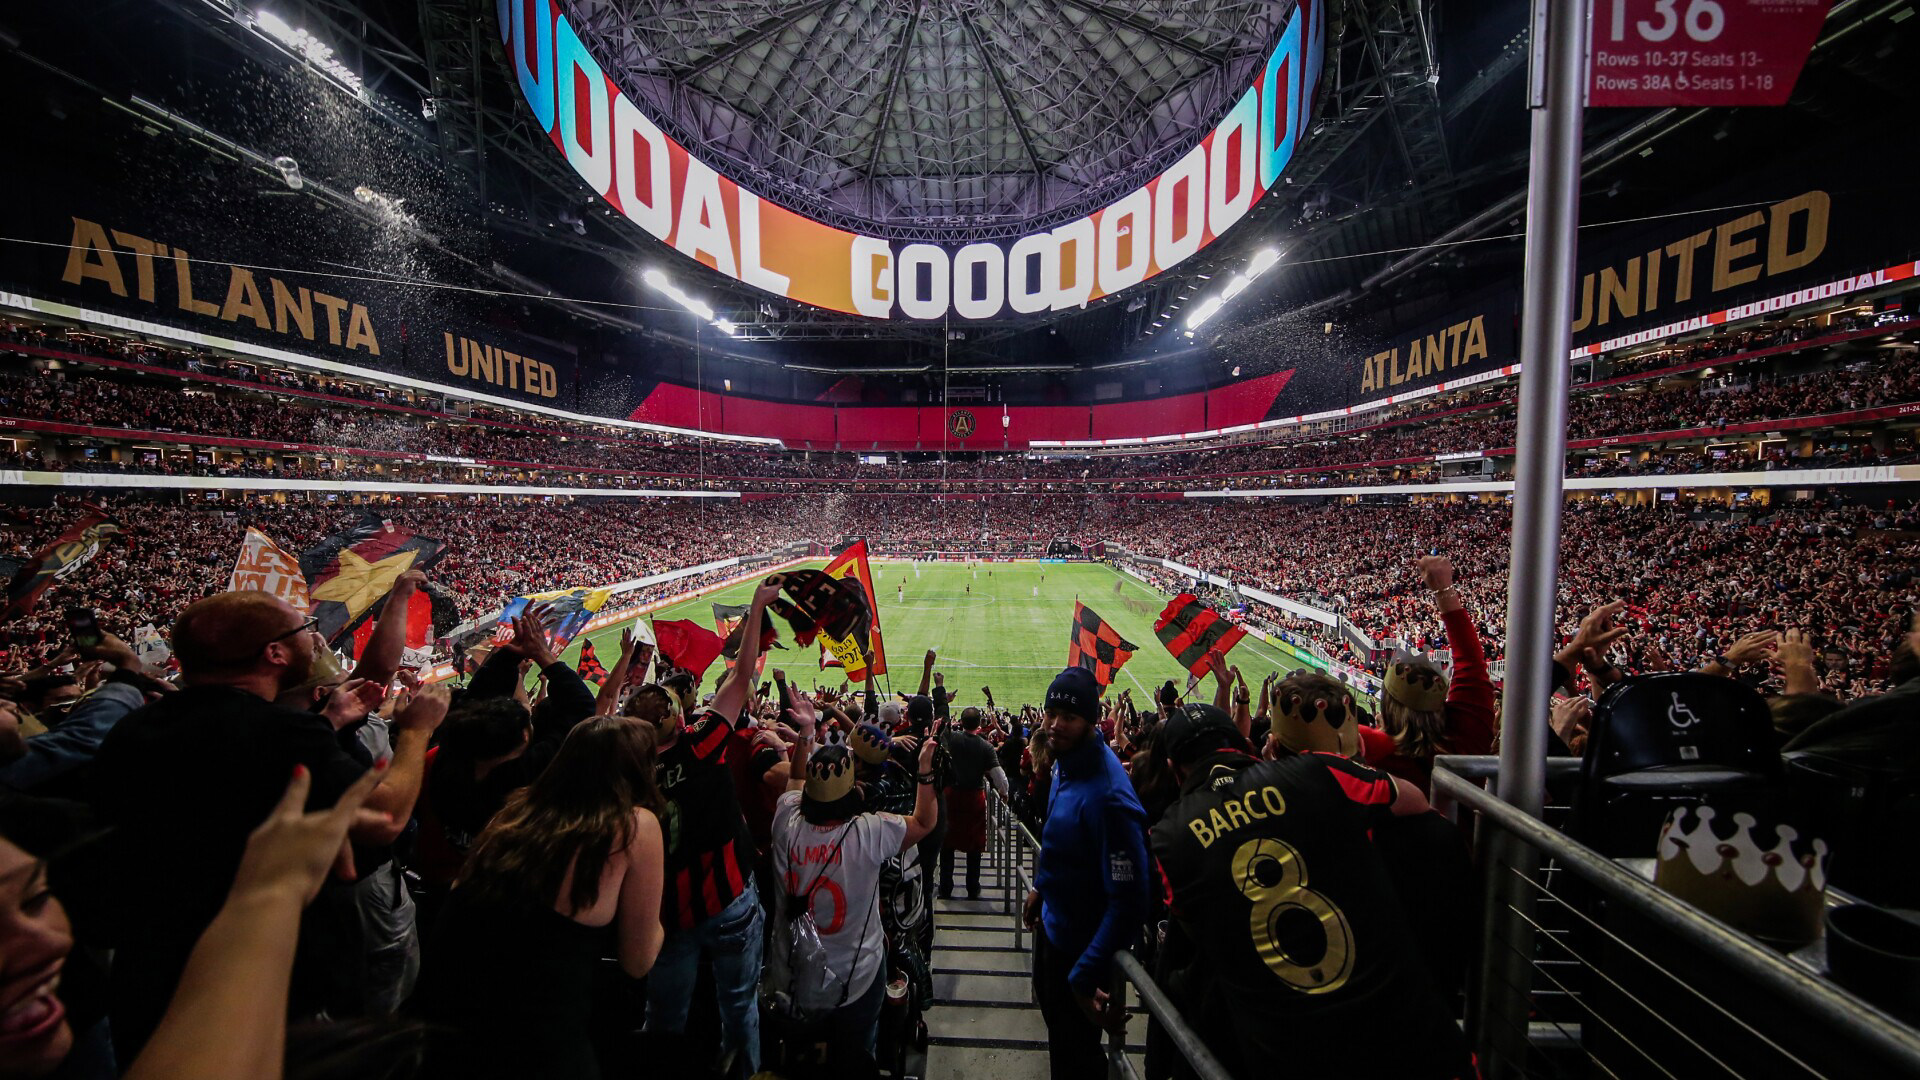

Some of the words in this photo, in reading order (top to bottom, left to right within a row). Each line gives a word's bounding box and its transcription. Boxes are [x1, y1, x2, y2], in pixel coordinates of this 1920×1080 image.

[1609, 0, 1725, 42] 136
[1597, 52, 1639, 67] Rows
[1645, 52, 1688, 67] 10-37
[1691, 52, 1734, 67] Seats
[1739, 52, 1764, 67] 13-
[1597, 75, 1638, 90] Rows
[1642, 75, 1671, 90] 38A
[1691, 75, 1734, 90] Seats
[1740, 75, 1773, 90] 1-18
[62, 217, 380, 356] ATLANTA
[444, 333, 557, 398] UNITED
[1361, 315, 1488, 394] ATLANTA
[1050, 691, 1077, 704] SAFE
[1211, 776, 1234, 791] UNITED
[1188, 786, 1286, 848] BARCO
[1231, 837, 1356, 995] 8
